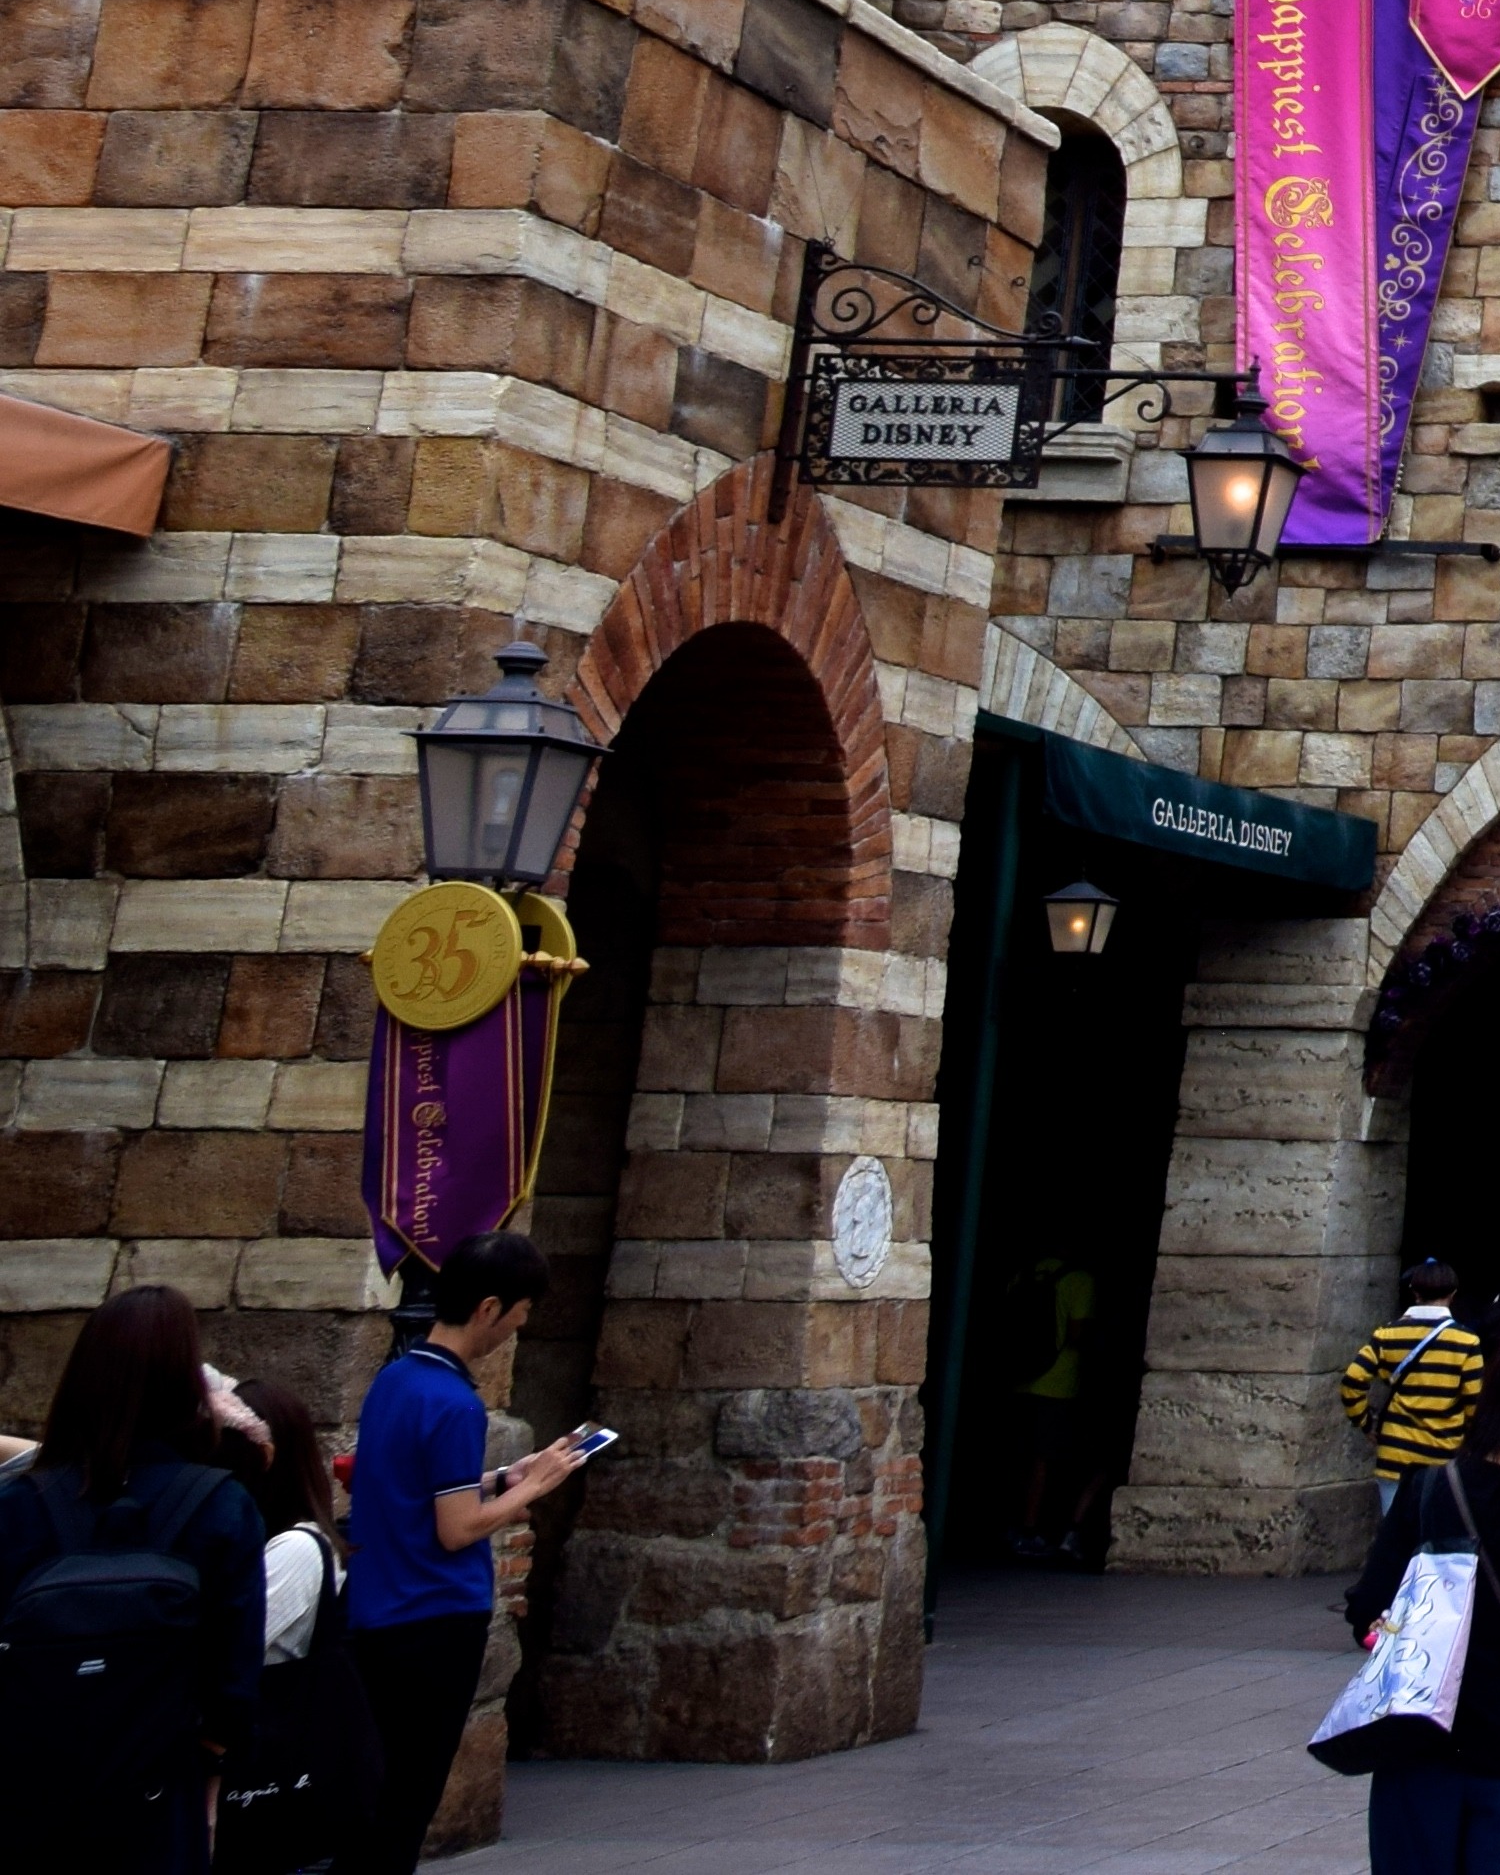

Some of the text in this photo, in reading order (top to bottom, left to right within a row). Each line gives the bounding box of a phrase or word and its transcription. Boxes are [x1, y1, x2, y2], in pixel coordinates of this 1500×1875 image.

[849, 394, 1005, 416] GALLERIA
[861, 422, 984, 446] DISNEY
[1152, 797, 1293, 857] GALLERIA DISNEY
[389, 908, 497, 1002] 35
